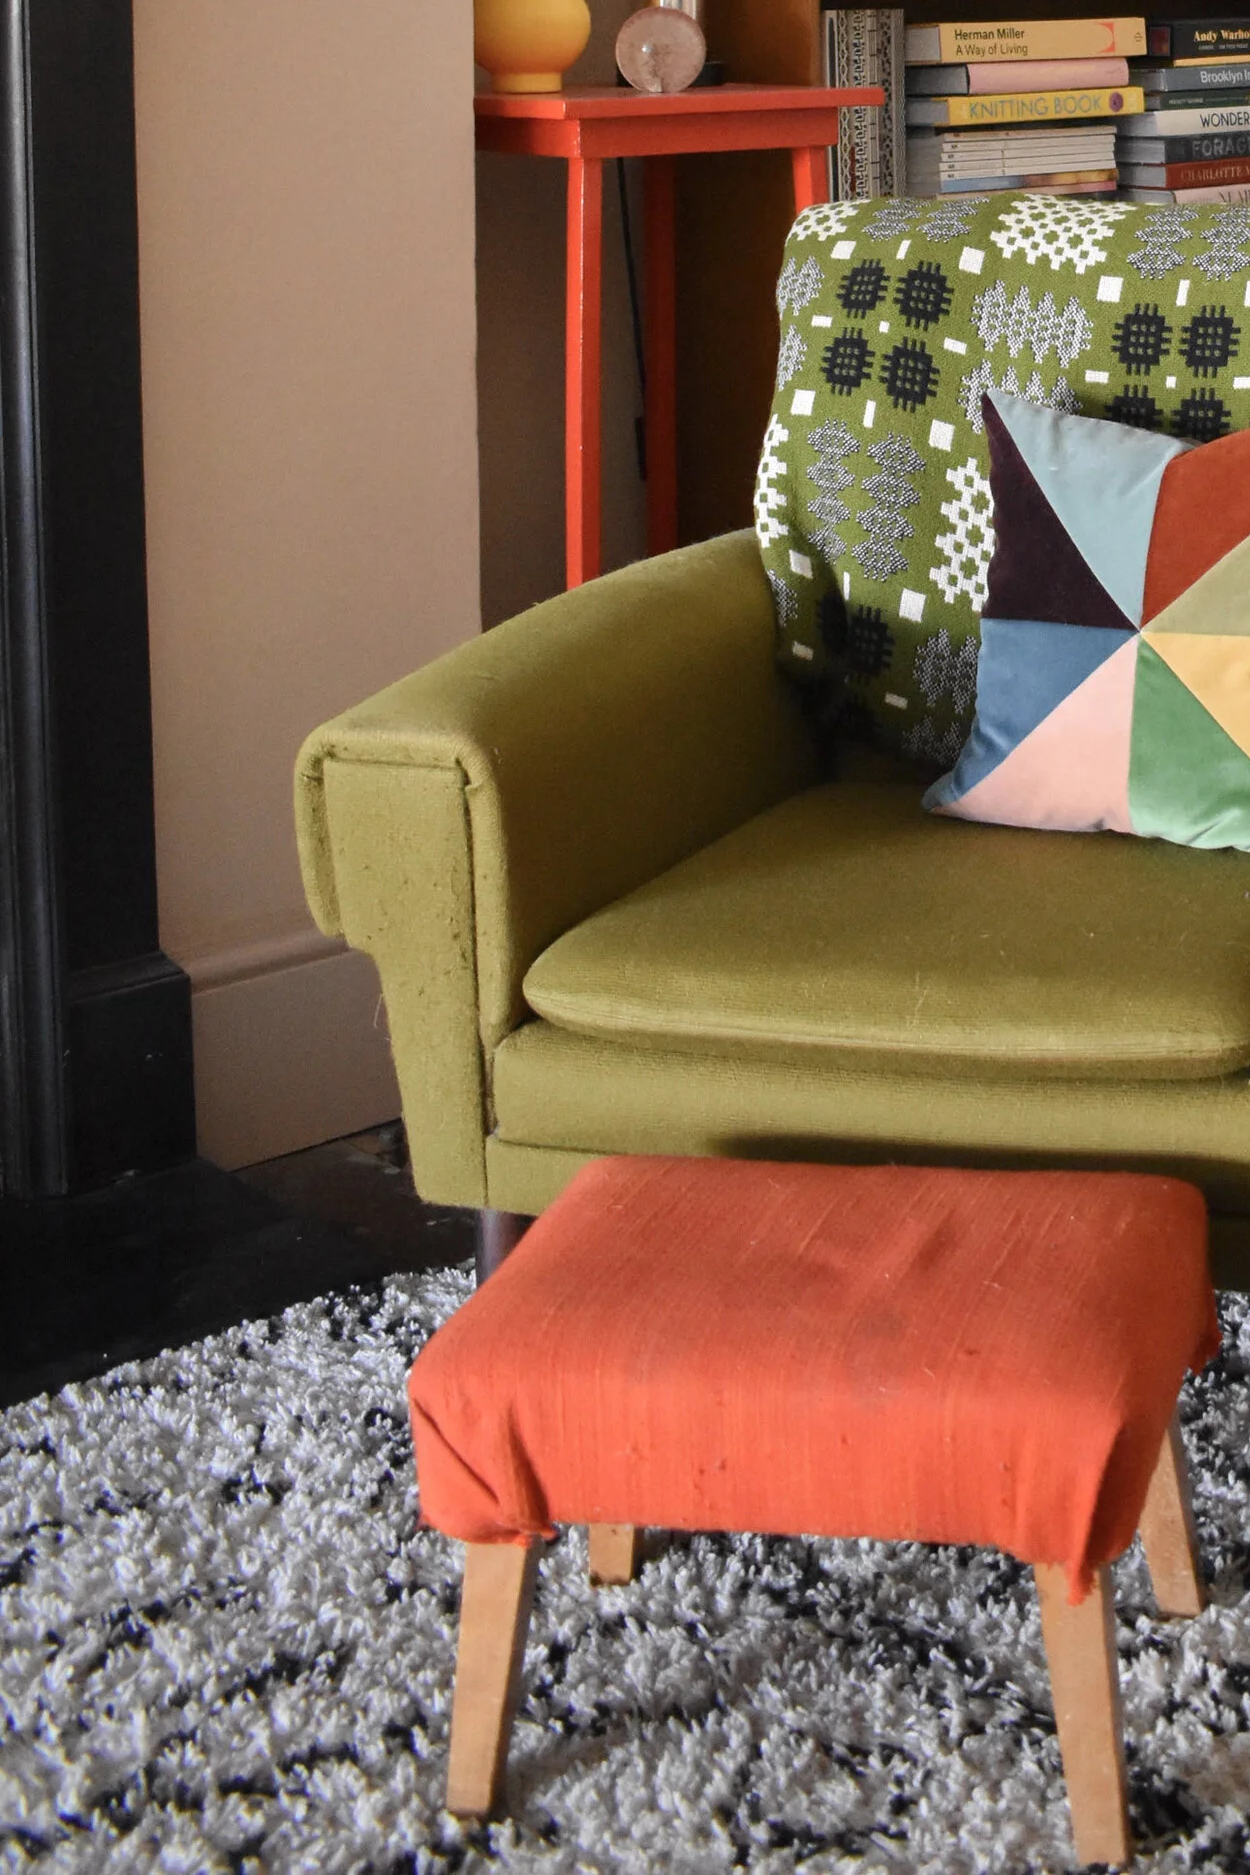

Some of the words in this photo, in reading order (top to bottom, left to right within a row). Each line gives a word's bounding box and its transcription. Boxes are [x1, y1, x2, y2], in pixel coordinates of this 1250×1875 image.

[954, 28, 995, 41] Herman
[996, 28, 1025, 40] Miller
[1193, 30, 1218, 43] Andy
[956, 45, 964, 55] A
[966, 44, 986, 57] Way
[987, 43, 997, 55] of
[1000, 43, 1028, 56] Living
[1200, 69, 1243, 84] Brooklyn
[969, 97, 1049, 119] KNITTING
[1054, 94, 1102, 115] BOOK
[1180, 165, 1242, 182] CHARLOTTE
